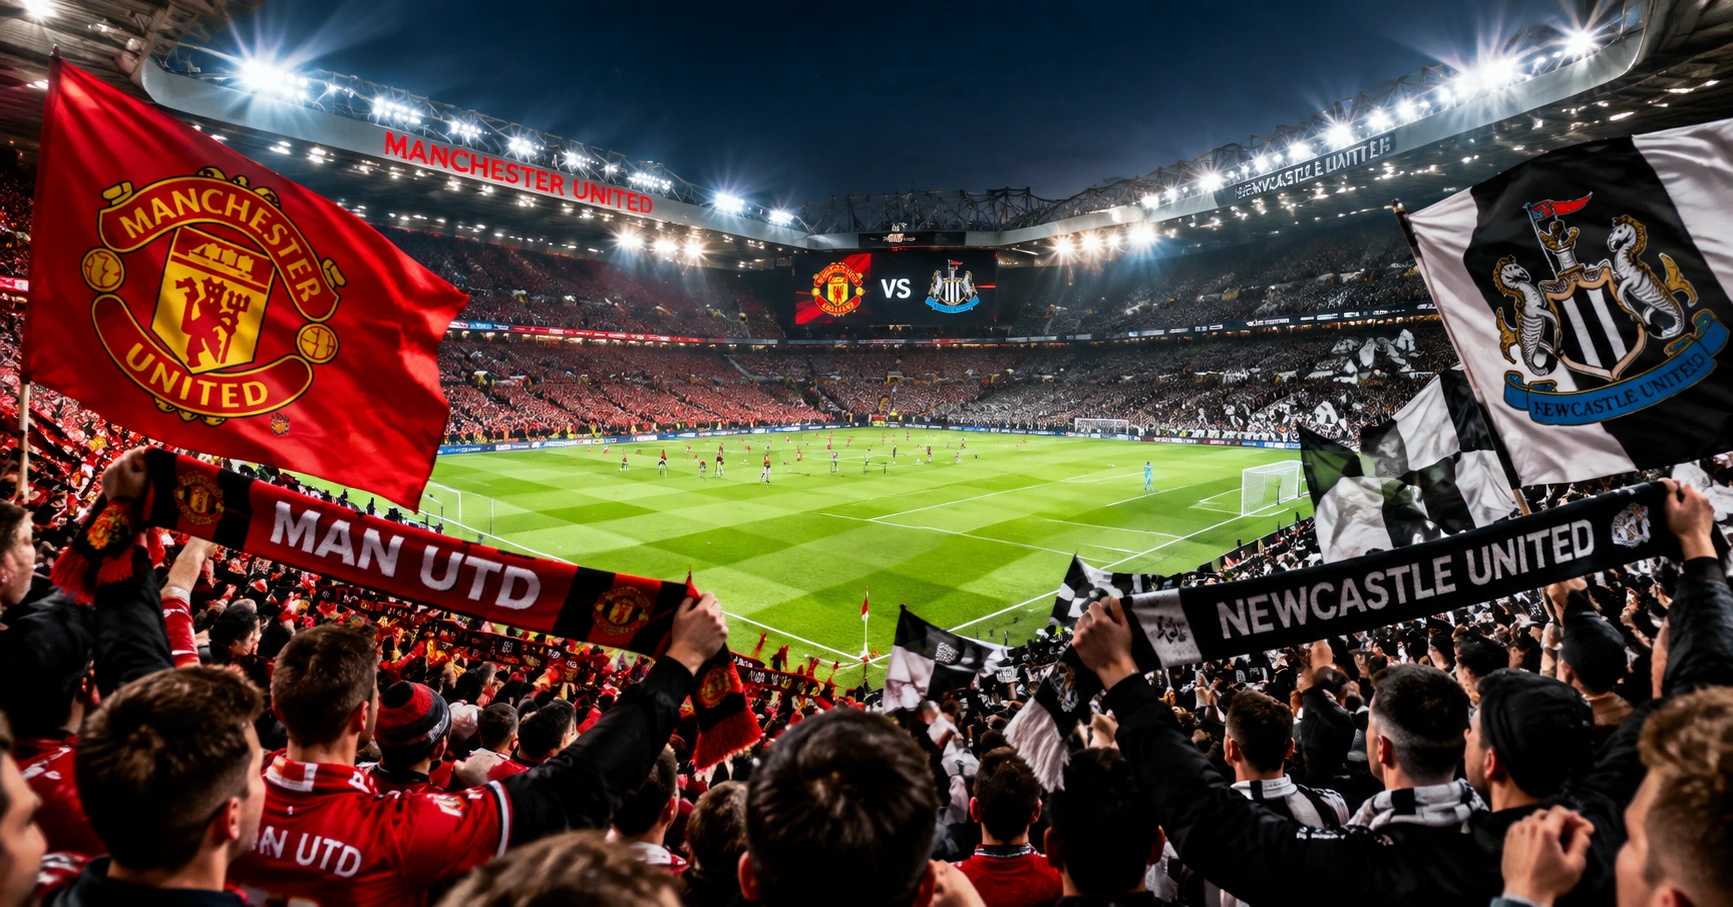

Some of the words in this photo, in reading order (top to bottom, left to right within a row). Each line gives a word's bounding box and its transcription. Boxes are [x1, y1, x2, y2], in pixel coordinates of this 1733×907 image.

[384, 131, 565, 196] MANCHESTER
[572, 178, 653, 214] UNITED
[119, 188, 321, 302] MANCHESTER
[881, 278, 911, 299] VS
[125, 342, 268, 408] UNITED
[1533, 389, 1638, 418] NEWCASTLE
[1640, 352, 1706, 398] UNITED
[270, 501, 404, 578] MAN
[420, 545, 541, 610] UTD
[1217, 554, 1456, 639] NEWCASTLE
[1466, 518, 1595, 586] UNITED
[251, 825, 288, 859] AN
[295, 833, 362, 878] UTD
